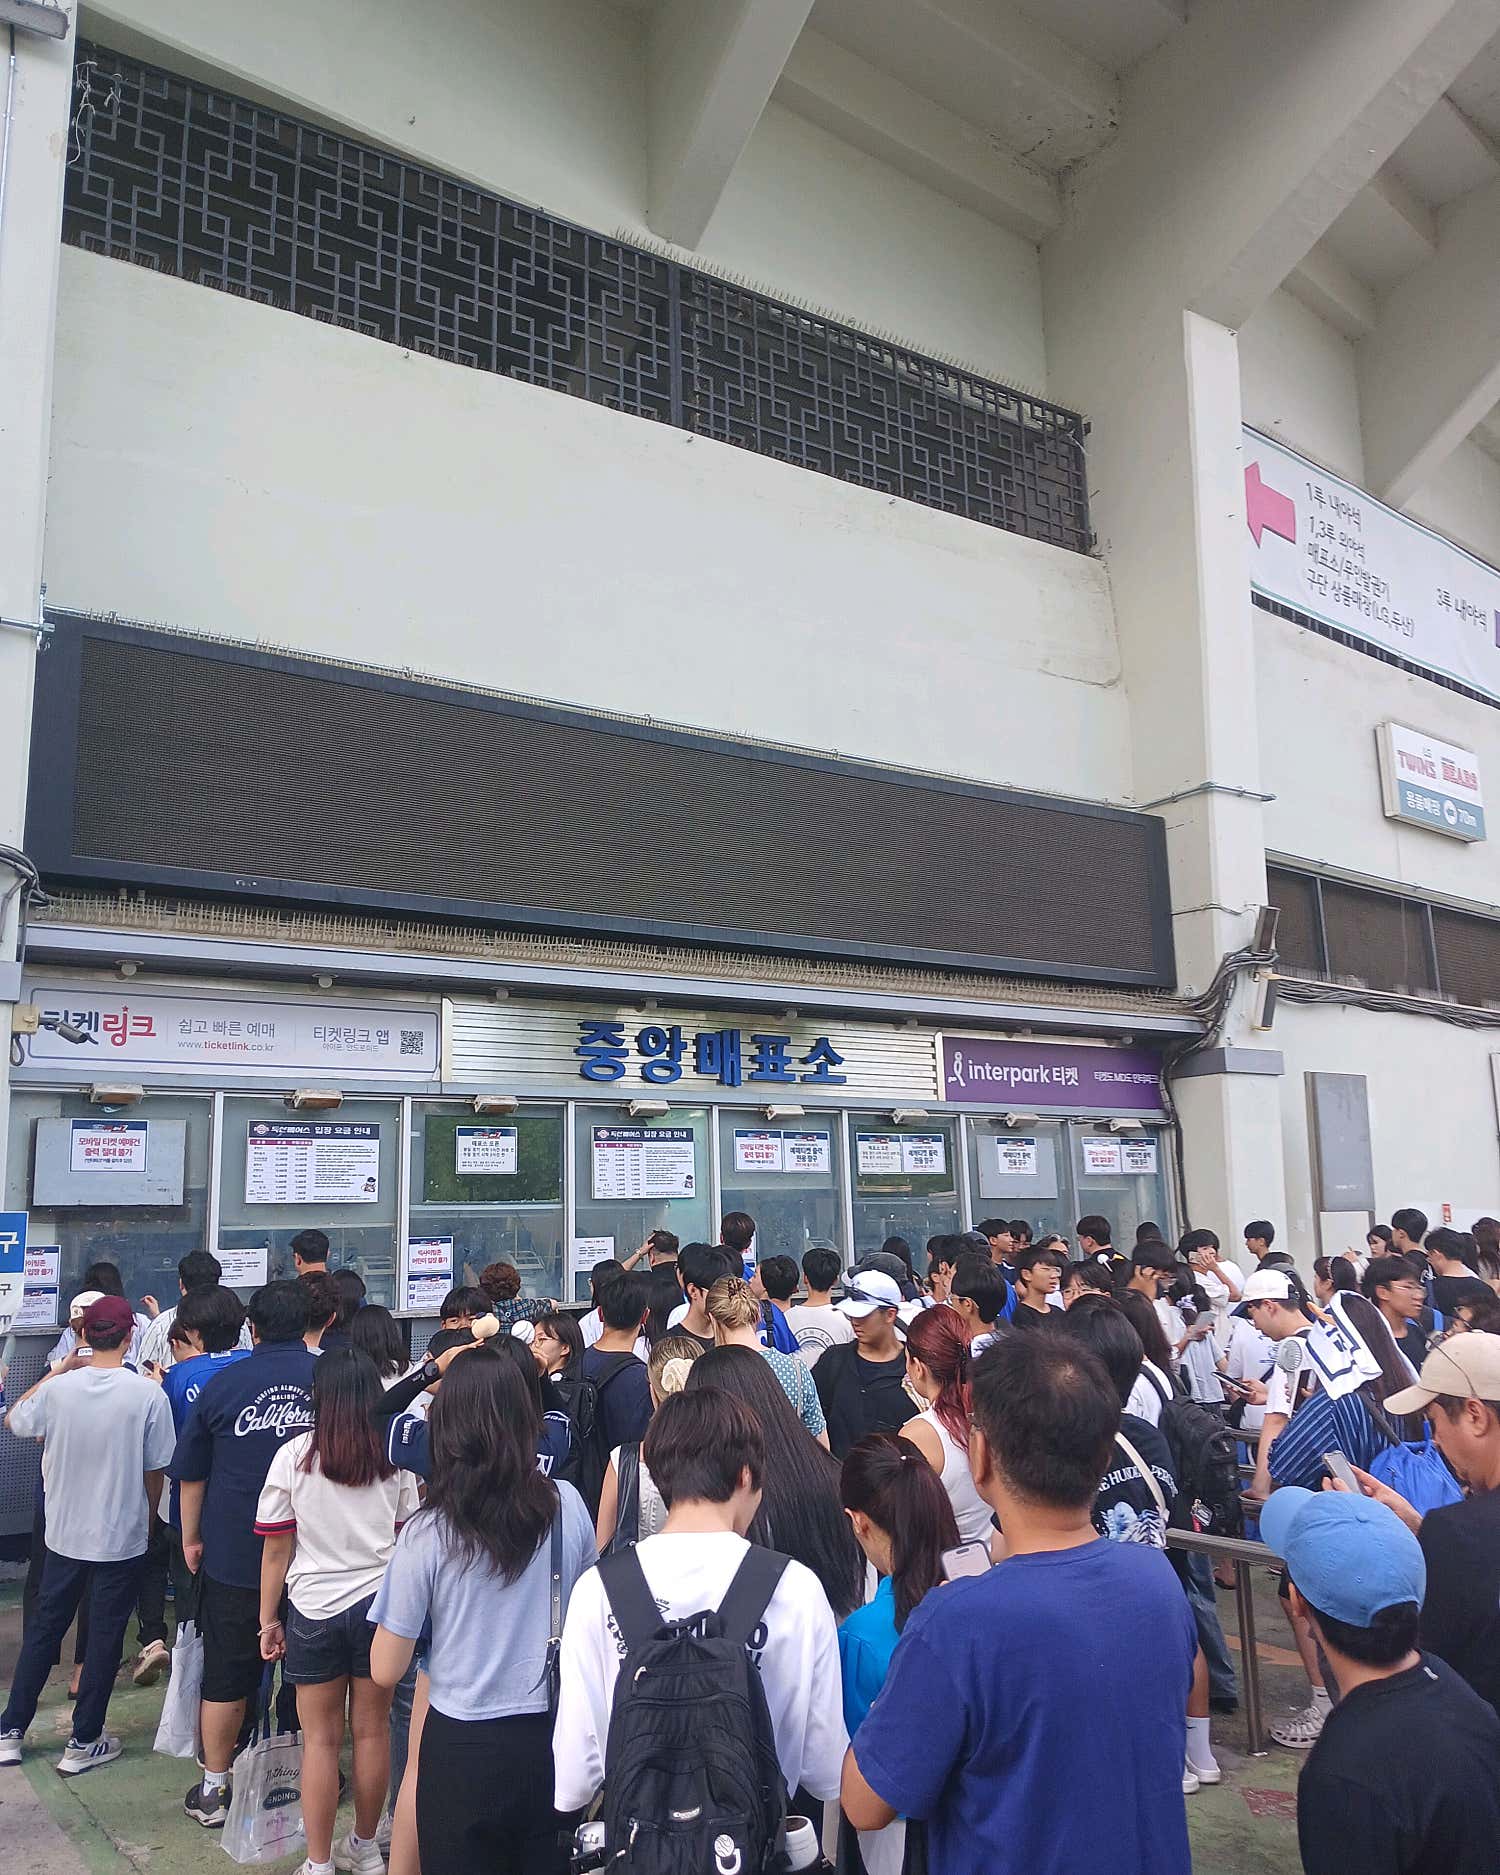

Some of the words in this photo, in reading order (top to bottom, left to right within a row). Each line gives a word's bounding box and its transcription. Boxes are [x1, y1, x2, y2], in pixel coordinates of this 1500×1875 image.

[1306, 482, 1327, 509] 1루
[1328, 494, 1362, 532] 내야석
[1310, 516, 1336, 544] 1,3루
[1307, 569, 1328, 596] 구단
[1397, 750, 1437, 779] TWINS
[178, 1018, 208, 1035] 쉽고
[213, 1020, 243, 1037] 빠른
[246, 1022, 276, 1038] 예매
[313, 1025, 371, 1044] 티켓링크
[376, 1029, 390, 1046] 앱
[177, 1039, 275, 1053] www.ticketlink.co.kr
[574, 1020, 847, 1087] 중앙매표소
[968, 1060, 1050, 1087] interpark
[1052, 1066, 1079, 1086] 티켓
[79, 1137, 101, 1147] 모바일
[102, 1137, 118, 1147] 티켓
[118, 1137, 140, 1147] 예매건
[315, 1126, 332, 1135] 입장
[334, 1127, 352, 1135] 요금
[354, 1127, 371, 1135] 안내
[102, 1147, 117, 1157] 절대
[118, 1147, 133, 1157] 불가
